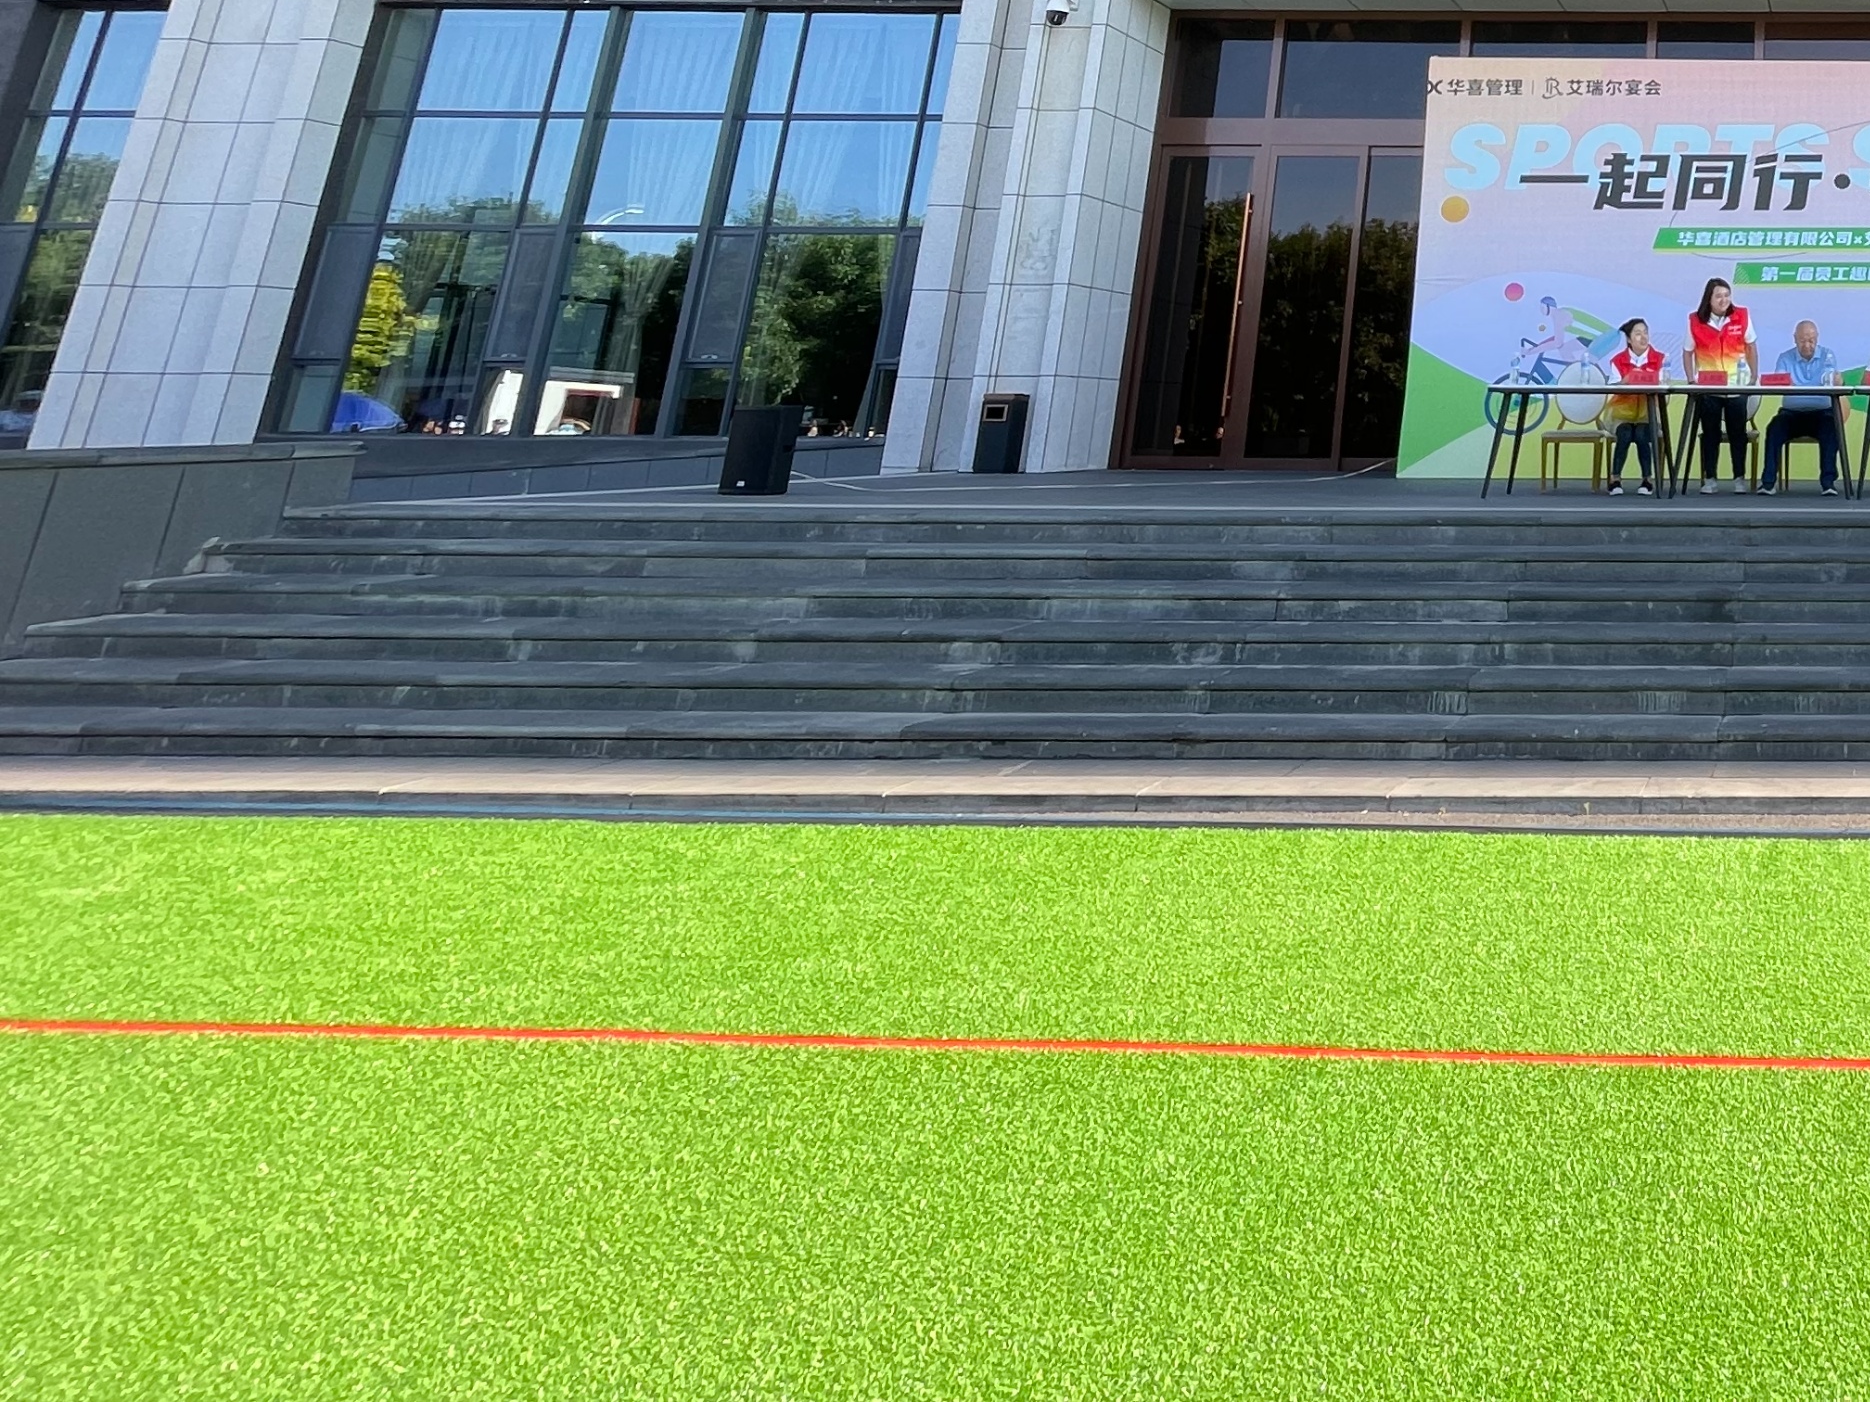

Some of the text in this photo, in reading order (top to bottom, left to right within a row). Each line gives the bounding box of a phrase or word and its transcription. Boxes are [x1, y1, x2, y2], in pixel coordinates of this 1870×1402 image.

[1447, 79, 1523, 96] 华喜管理
[1567, 79, 1661, 96] 艾瑞尔宴会
